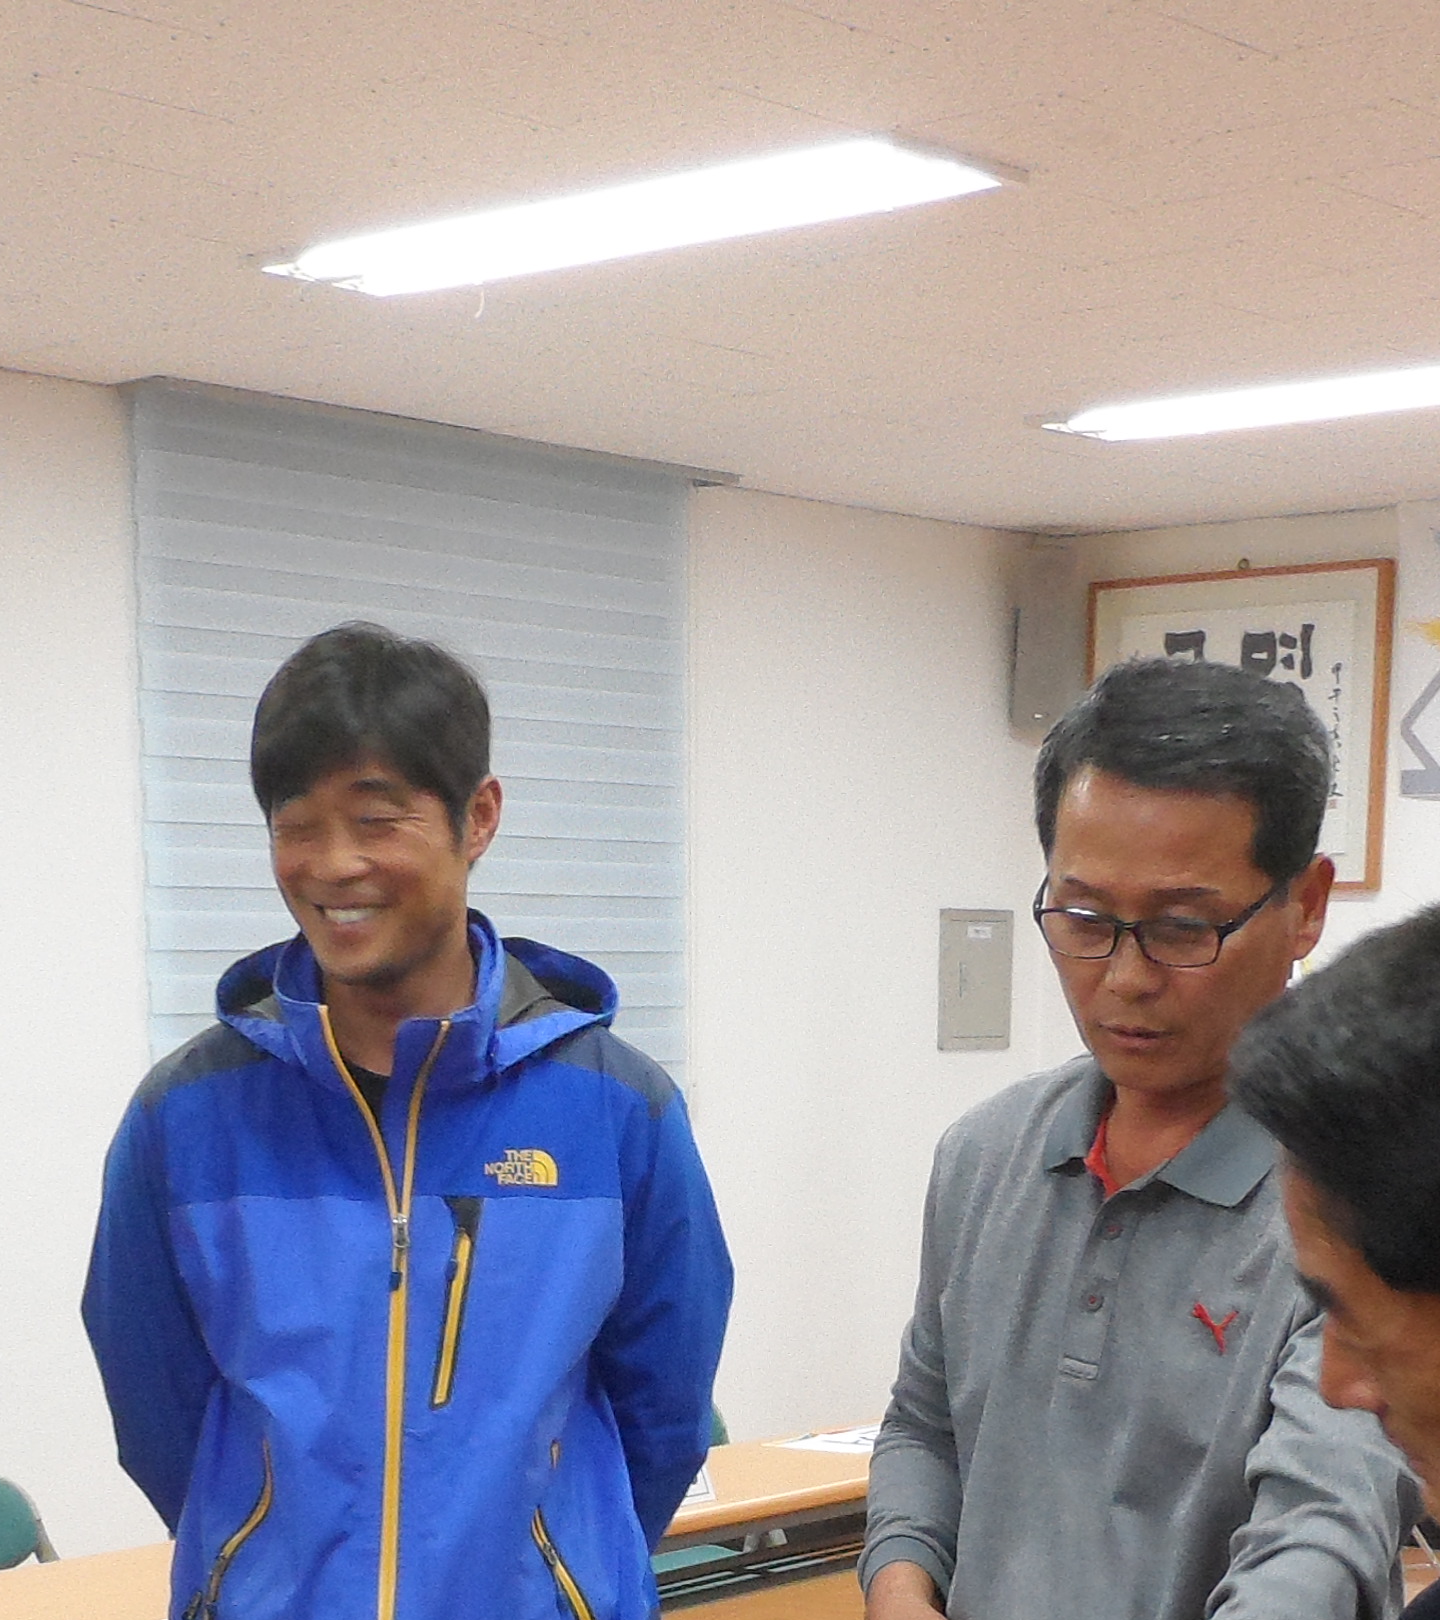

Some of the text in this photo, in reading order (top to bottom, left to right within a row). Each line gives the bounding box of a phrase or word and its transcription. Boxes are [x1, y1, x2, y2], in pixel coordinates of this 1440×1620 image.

[504, 1149, 533, 1162] THE
[484, 1162, 533, 1175] NORTH
[498, 1174, 533, 1185] FACE
